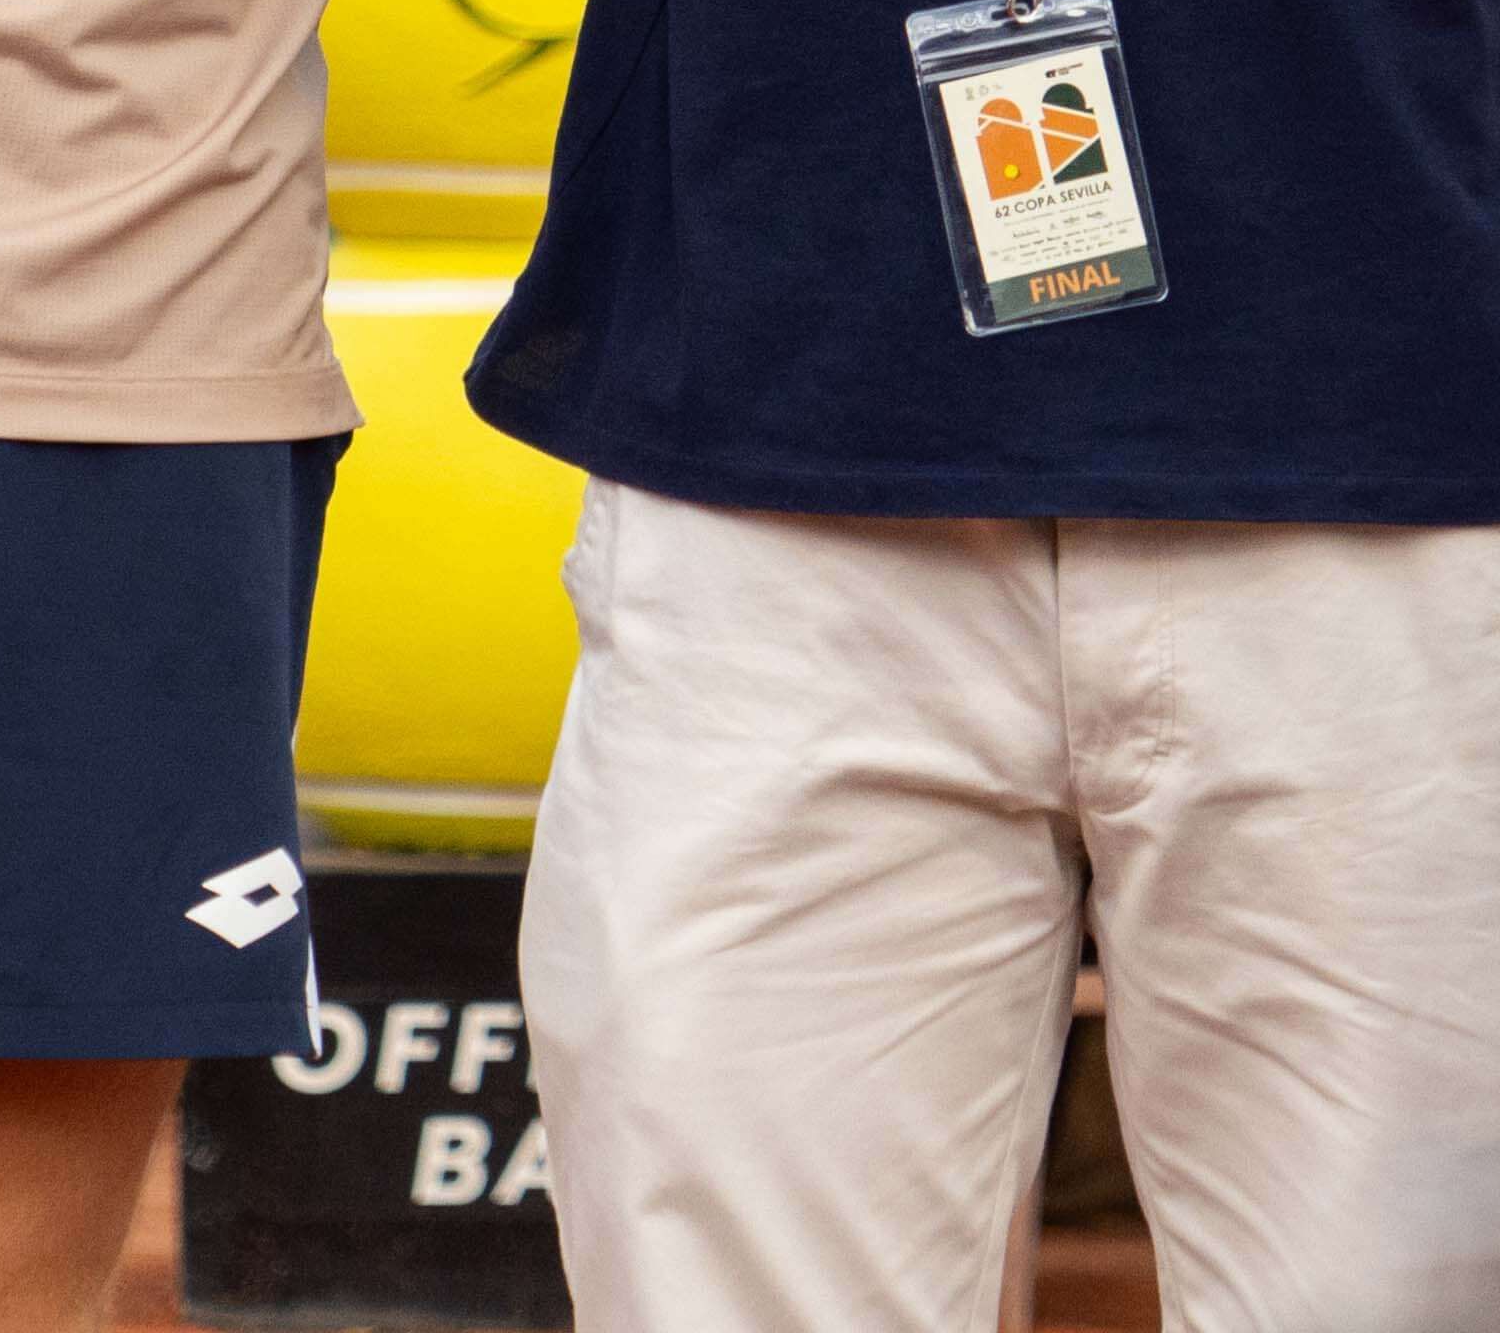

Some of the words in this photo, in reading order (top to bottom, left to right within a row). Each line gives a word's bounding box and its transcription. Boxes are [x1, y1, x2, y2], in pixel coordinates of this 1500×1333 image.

[994, 205, 1011, 219] 62
[1014, 195, 1056, 214] COPA
[1060, 180, 1113, 203] SEVILLA
[1028, 261, 1121, 304] FINAL
[271, 1000, 536, 1095] OFF
